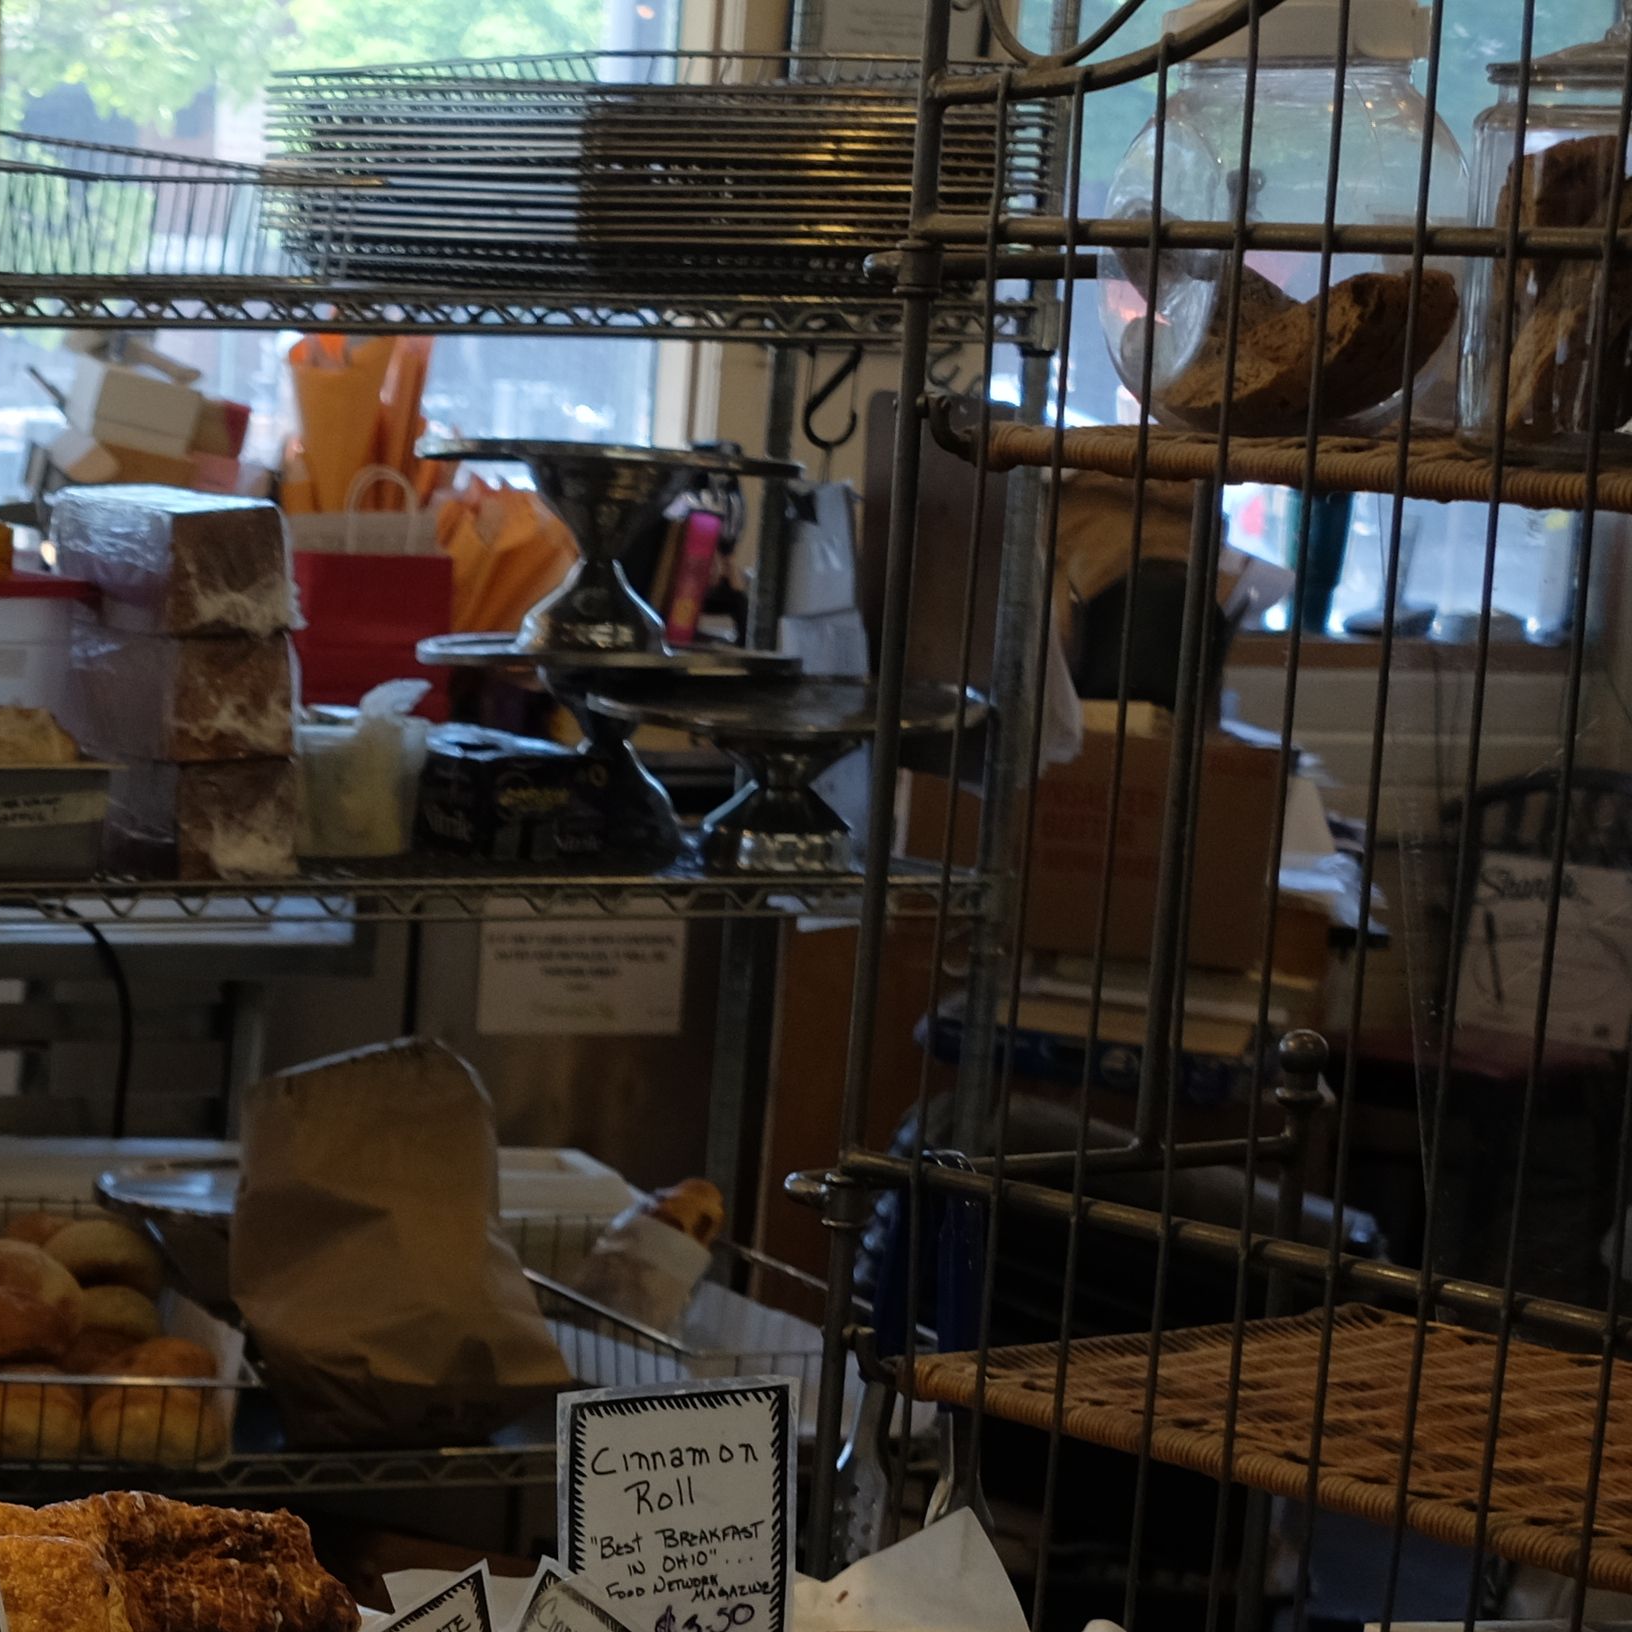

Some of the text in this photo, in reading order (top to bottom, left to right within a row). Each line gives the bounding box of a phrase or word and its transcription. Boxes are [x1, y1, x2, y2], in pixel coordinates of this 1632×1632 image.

[591, 1442, 759, 1475] Cinnamon
[624, 1476, 695, 1515] Roll
[628, 1563, 646, 1576] IN
